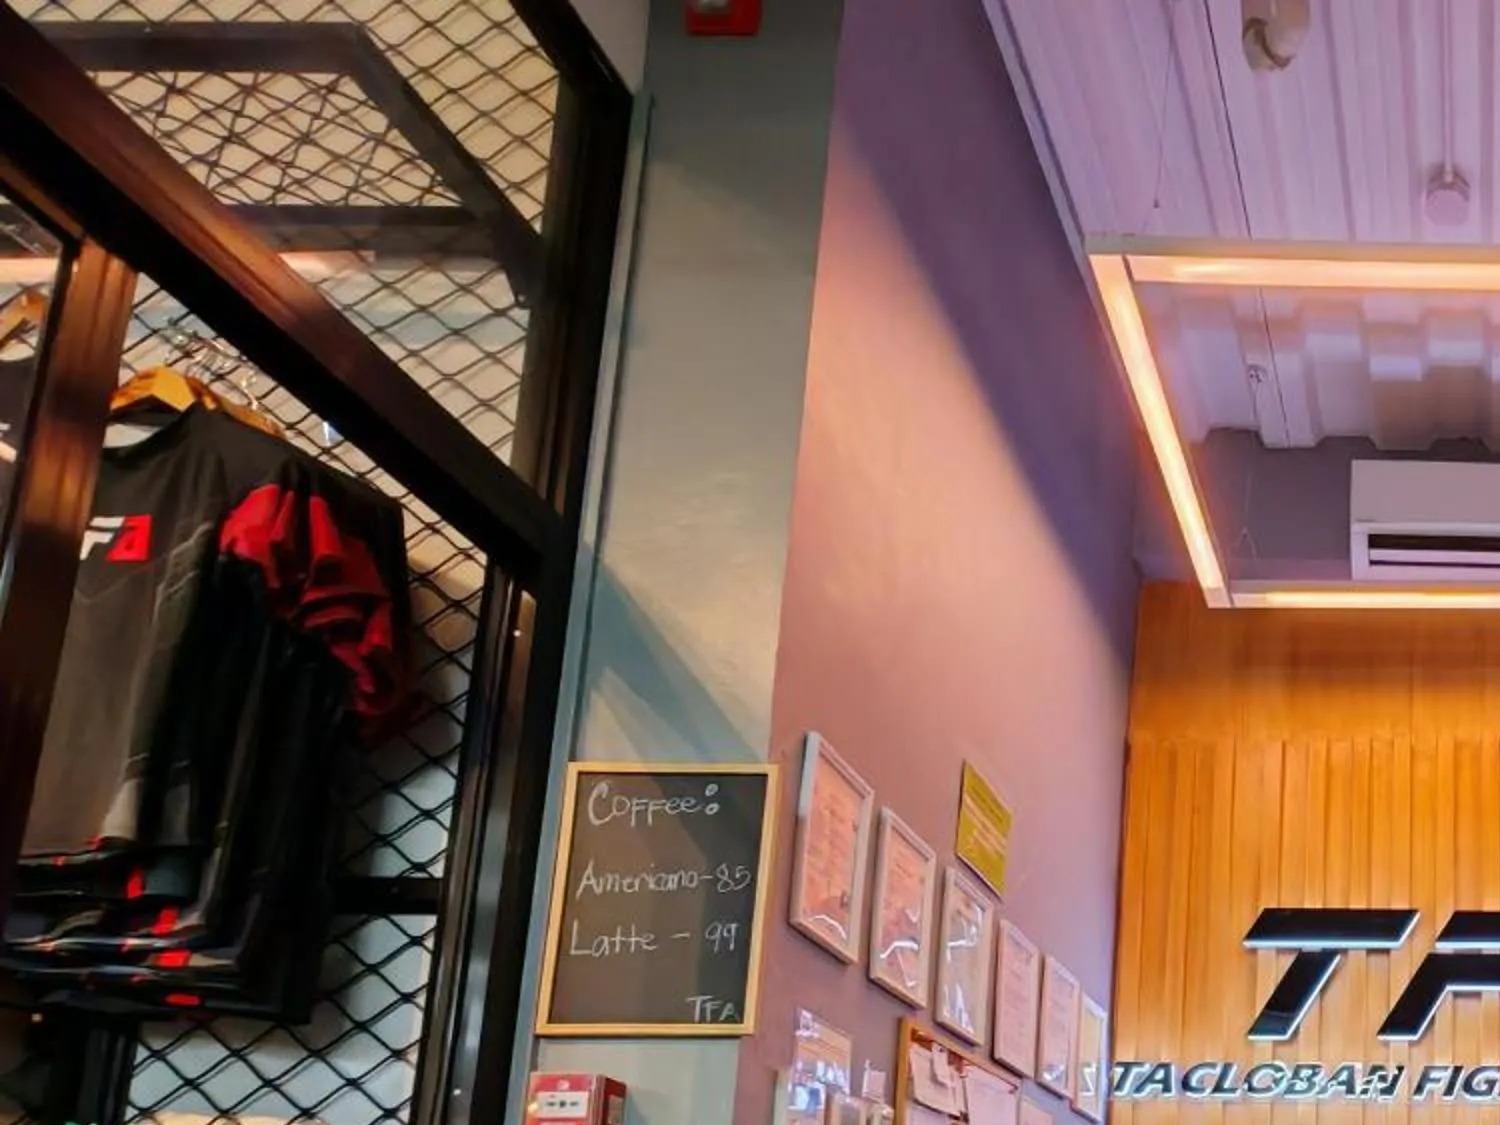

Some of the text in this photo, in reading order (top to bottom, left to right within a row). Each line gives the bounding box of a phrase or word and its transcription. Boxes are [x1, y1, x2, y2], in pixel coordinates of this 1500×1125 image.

[569, 919, 659, 957] Latte
[704, 922, 739, 952] 99
[1110, 1060, 1402, 1100] TACLOBAN
